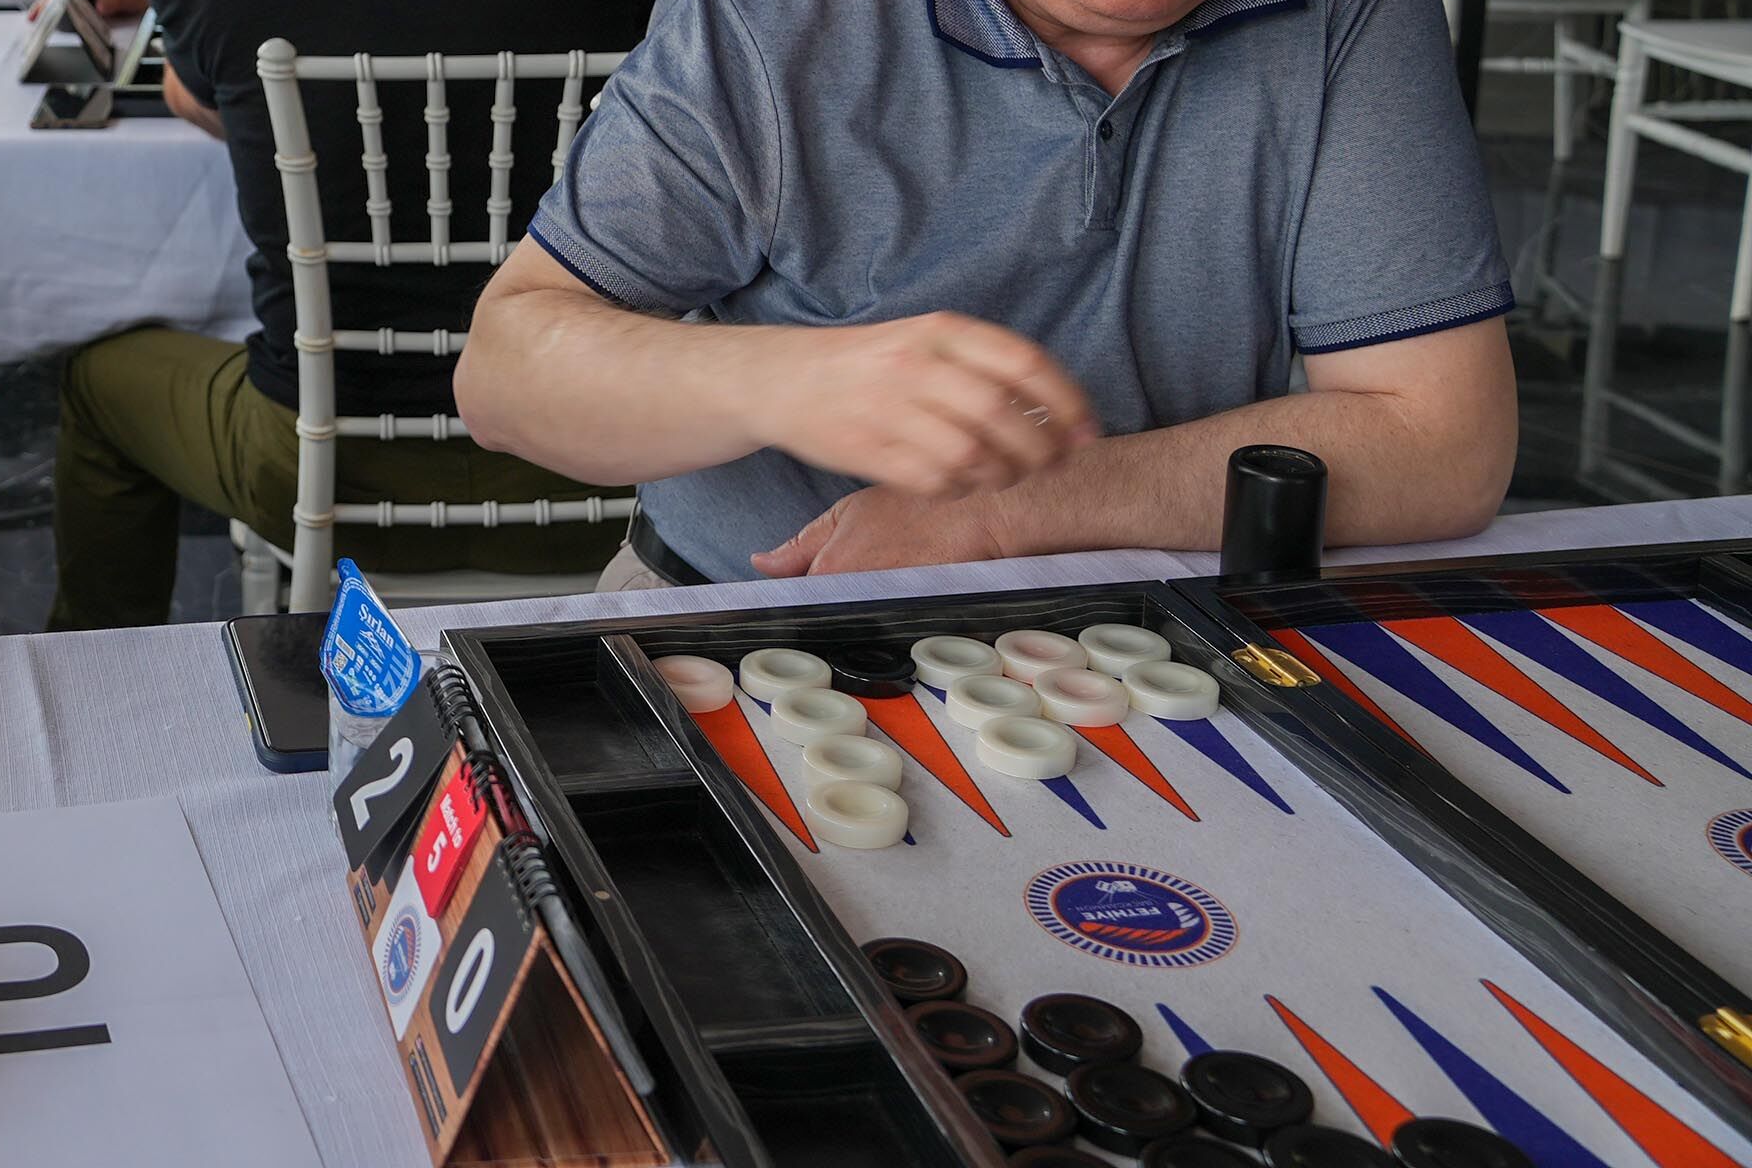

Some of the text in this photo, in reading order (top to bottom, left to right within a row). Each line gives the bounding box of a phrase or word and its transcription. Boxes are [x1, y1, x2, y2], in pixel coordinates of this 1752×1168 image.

[358, 603, 395, 649] Şırlan
[349, 736, 415, 831] 2
[427, 830, 448, 873] 5
[446, 927, 495, 1034] 0
